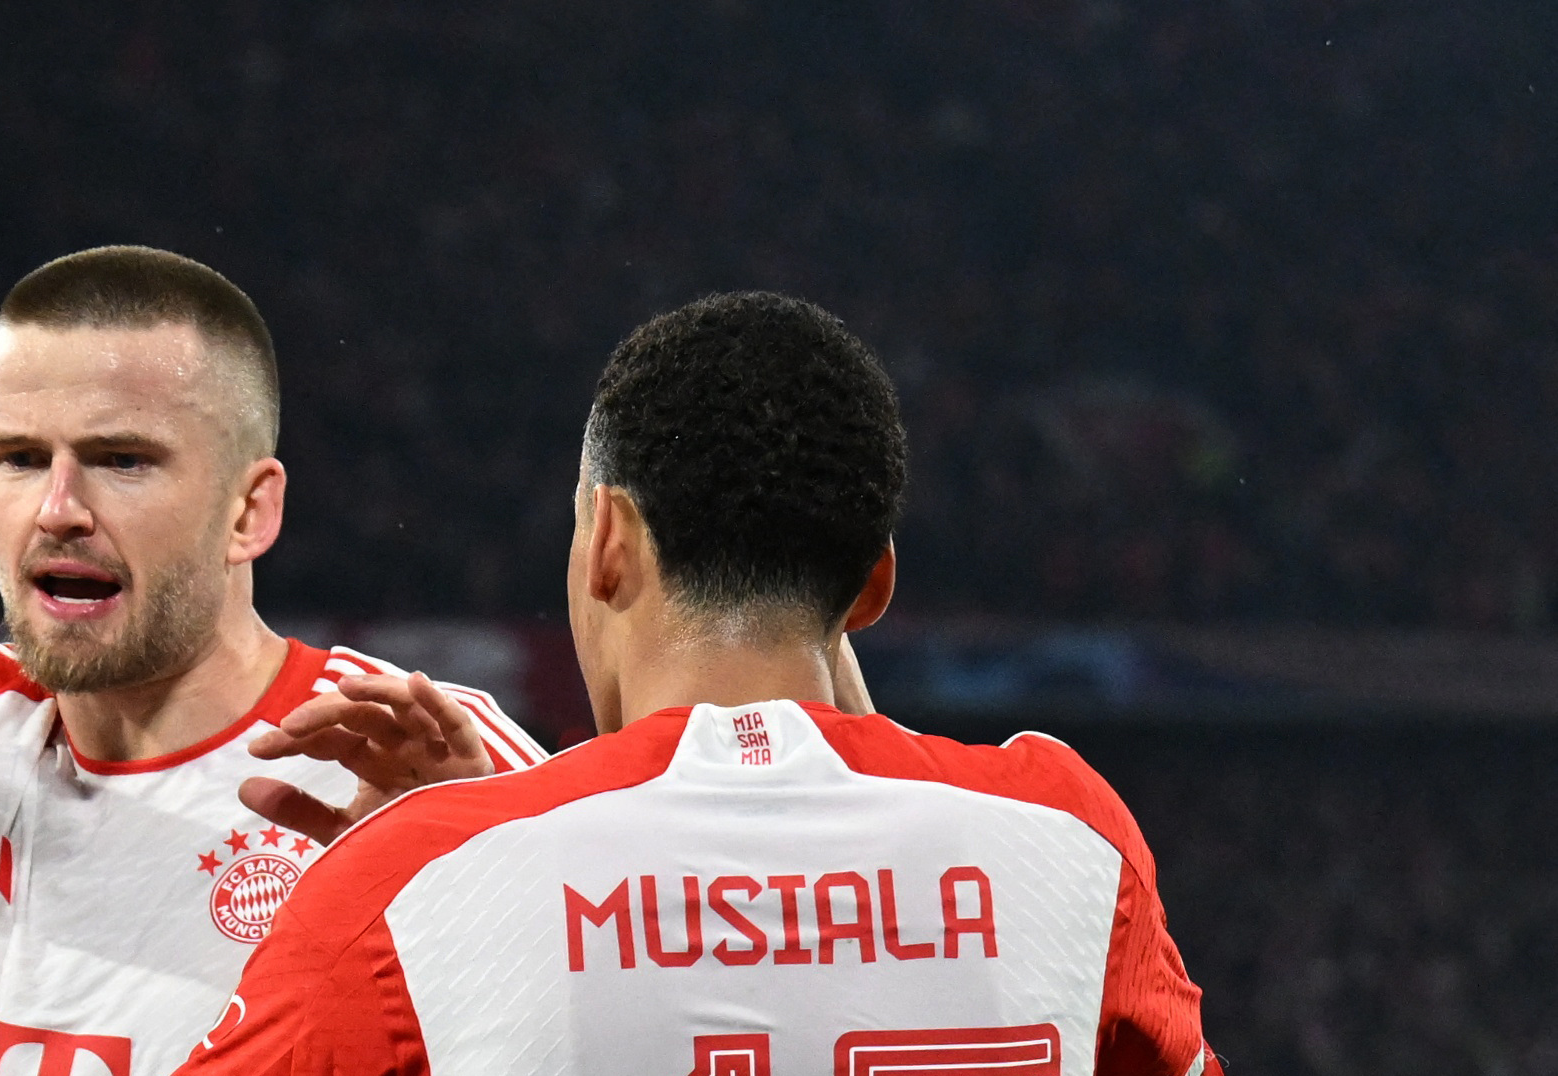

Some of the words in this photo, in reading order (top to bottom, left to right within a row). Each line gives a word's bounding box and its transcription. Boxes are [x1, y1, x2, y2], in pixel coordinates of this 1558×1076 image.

[732, 711, 764, 732] MIA
[737, 730, 769, 748] SAN
[741, 748, 771, 765] MIA
[222, 872, 242, 892] FC
[563, 866, 998, 972] MUSIALA
